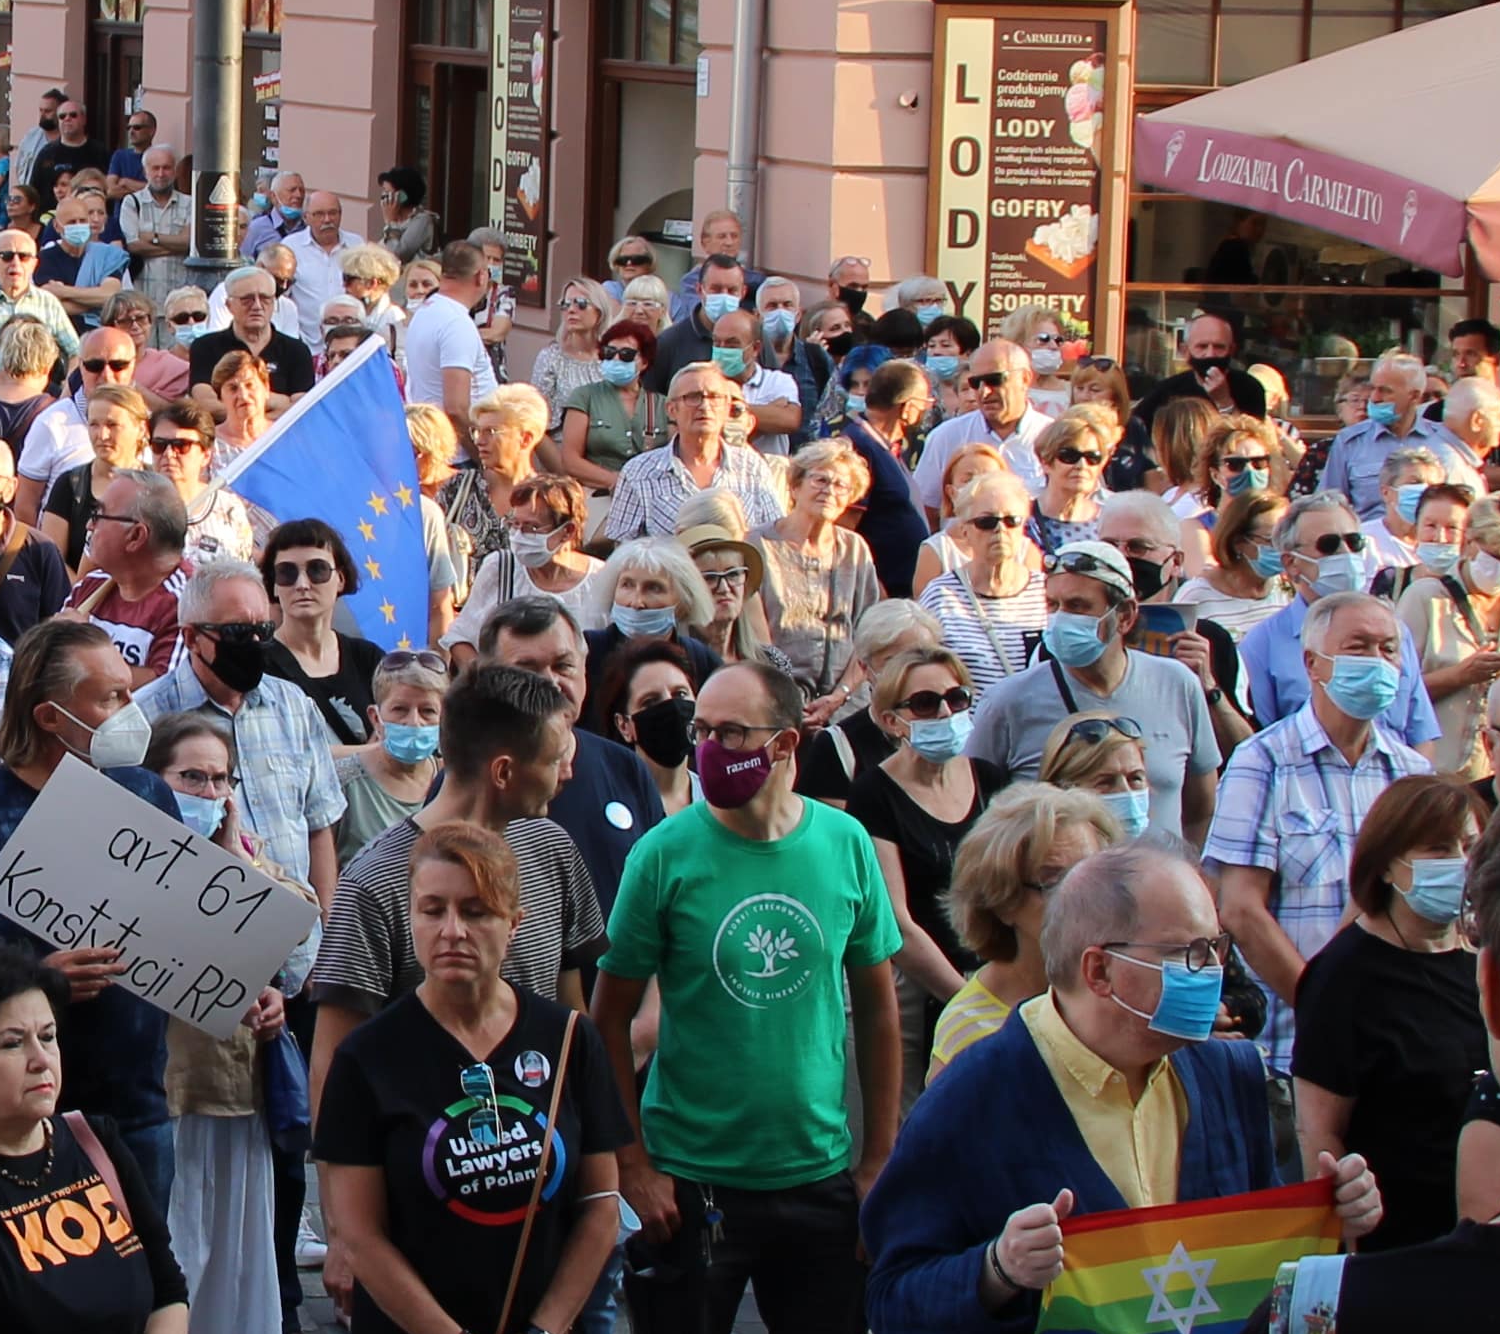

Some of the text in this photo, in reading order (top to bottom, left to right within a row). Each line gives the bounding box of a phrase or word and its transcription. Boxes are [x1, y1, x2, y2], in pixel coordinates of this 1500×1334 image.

[1013, 30, 1083, 45] CARMELITO
[998, 69, 1059, 83] Codziennie
[509, 82, 529, 99] LODY
[997, 84, 1067, 99] produkujemy
[997, 96, 1036, 109] świeże
[995, 119, 1056, 138] LODY
[507, 150, 532, 168] GOFRY
[944, 64, 981, 317] LODY
[1283, 158, 1383, 226] CARMELITO
[991, 198, 1065, 218] GOFRY
[726, 756, 761, 775] razem
[108, 827, 273, 934] art. 61
[173, 964, 247, 1023] RP
[445, 1140, 543, 1178] Lawyers
[460, 1178, 480, 1195] of
